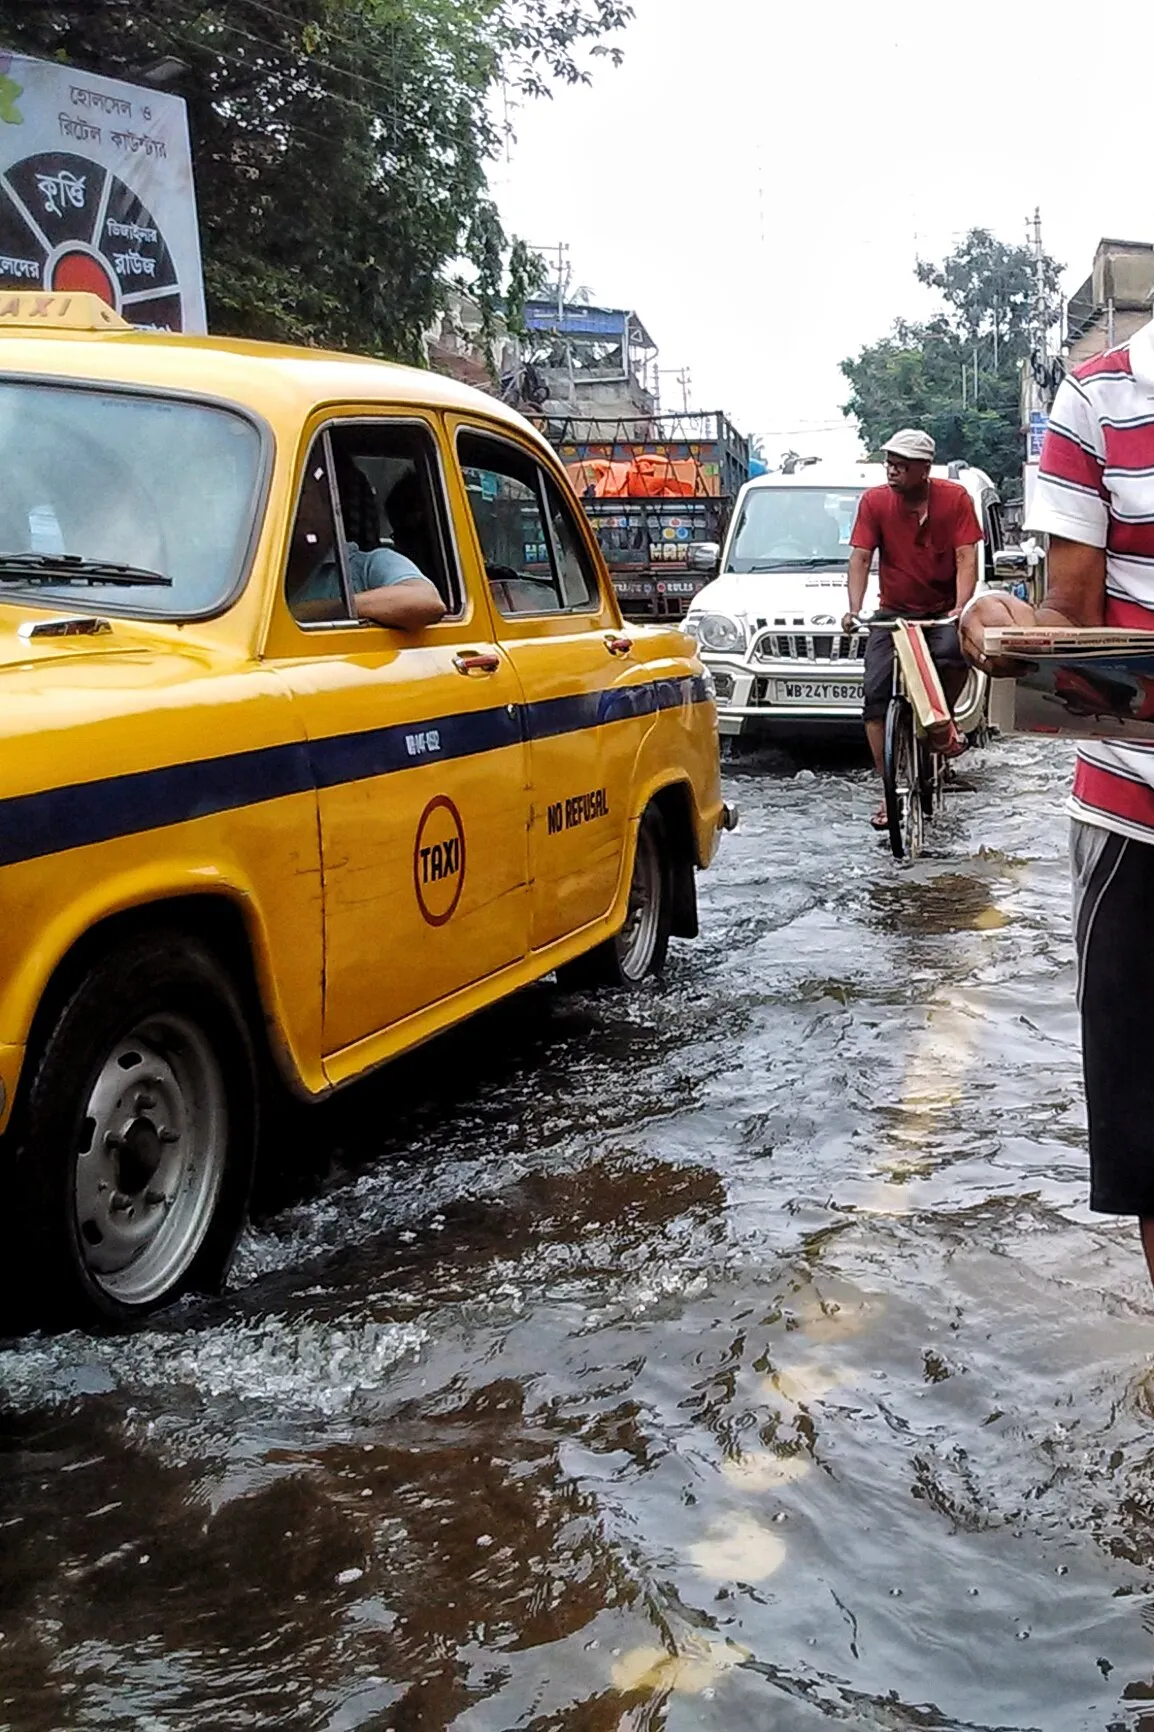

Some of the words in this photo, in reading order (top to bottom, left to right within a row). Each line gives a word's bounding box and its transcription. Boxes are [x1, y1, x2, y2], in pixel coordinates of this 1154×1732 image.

[68, 84, 132, 118] হোলসেল
[142, 105, 152, 121] ও
[58, 111, 101, 145] রিটেল
[832, 685, 865, 699] 6820
[548, 802, 563, 835] NO
[565, 788, 609, 829] REFUSAL
[420, 837, 459, 884] TAXI
